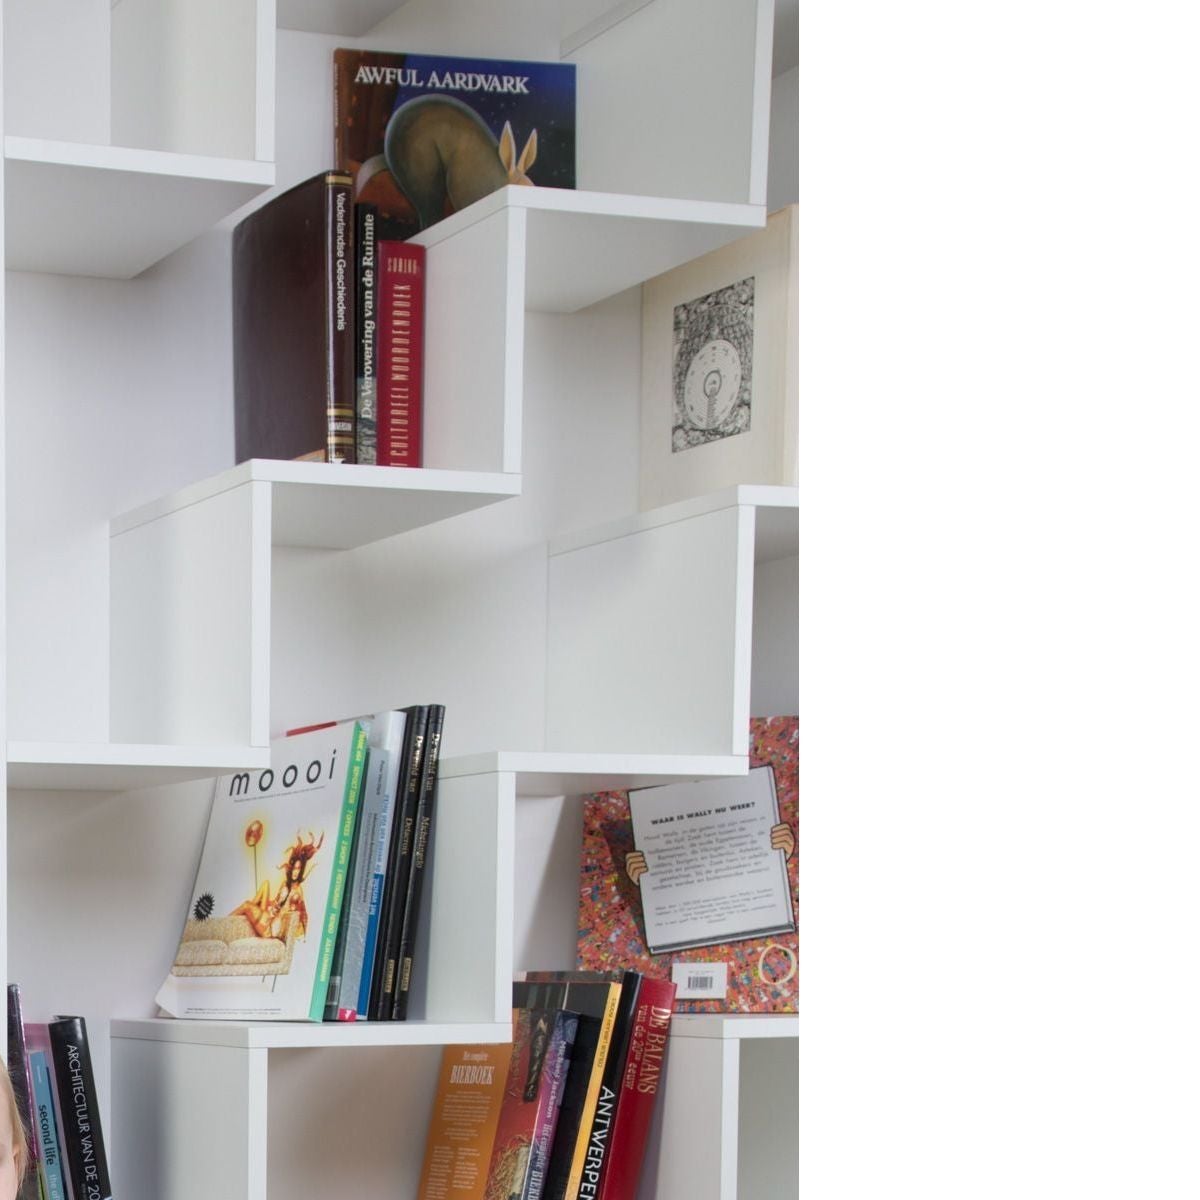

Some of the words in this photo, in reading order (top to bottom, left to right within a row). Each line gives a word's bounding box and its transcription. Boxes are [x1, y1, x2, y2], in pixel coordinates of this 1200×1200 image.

[354, 65, 424, 88] AWFUL
[427, 70, 530, 94] AARDVARK
[336, 192, 347, 258] Vaderlandse
[362, 214, 375, 267] Ruimte
[362, 268, 374, 289] de
[336, 259, 347, 331] Geschiedenis
[363, 290, 374, 321] van
[361, 323, 376, 397] Verovering
[361, 398, 373, 419] De
[228, 749, 337, 797] moooi
[651, 816, 675, 825] WAAR
[686, 809, 712, 819] WALLY
[638, 1005, 649, 1022] van
[650, 1006, 672, 1030] DE
[635, 1024, 646, 1038] de
[553, 1040, 567, 1076] Michael
[637, 1031, 668, 1095] BALANS
[66, 1044, 90, 1134] ARCHITECTUUR
[450, 1065, 495, 1085] BIERBOEK
[625, 1063, 638, 1091] eeuw
[546, 1077, 561, 1119] Jackson
[39, 1104, 52, 1145] second
[45, 1146, 54, 1165] life
[81, 1134, 95, 1163] VAN
[50, 1174, 58, 1188] the
[85, 1164, 98, 1182] DE
